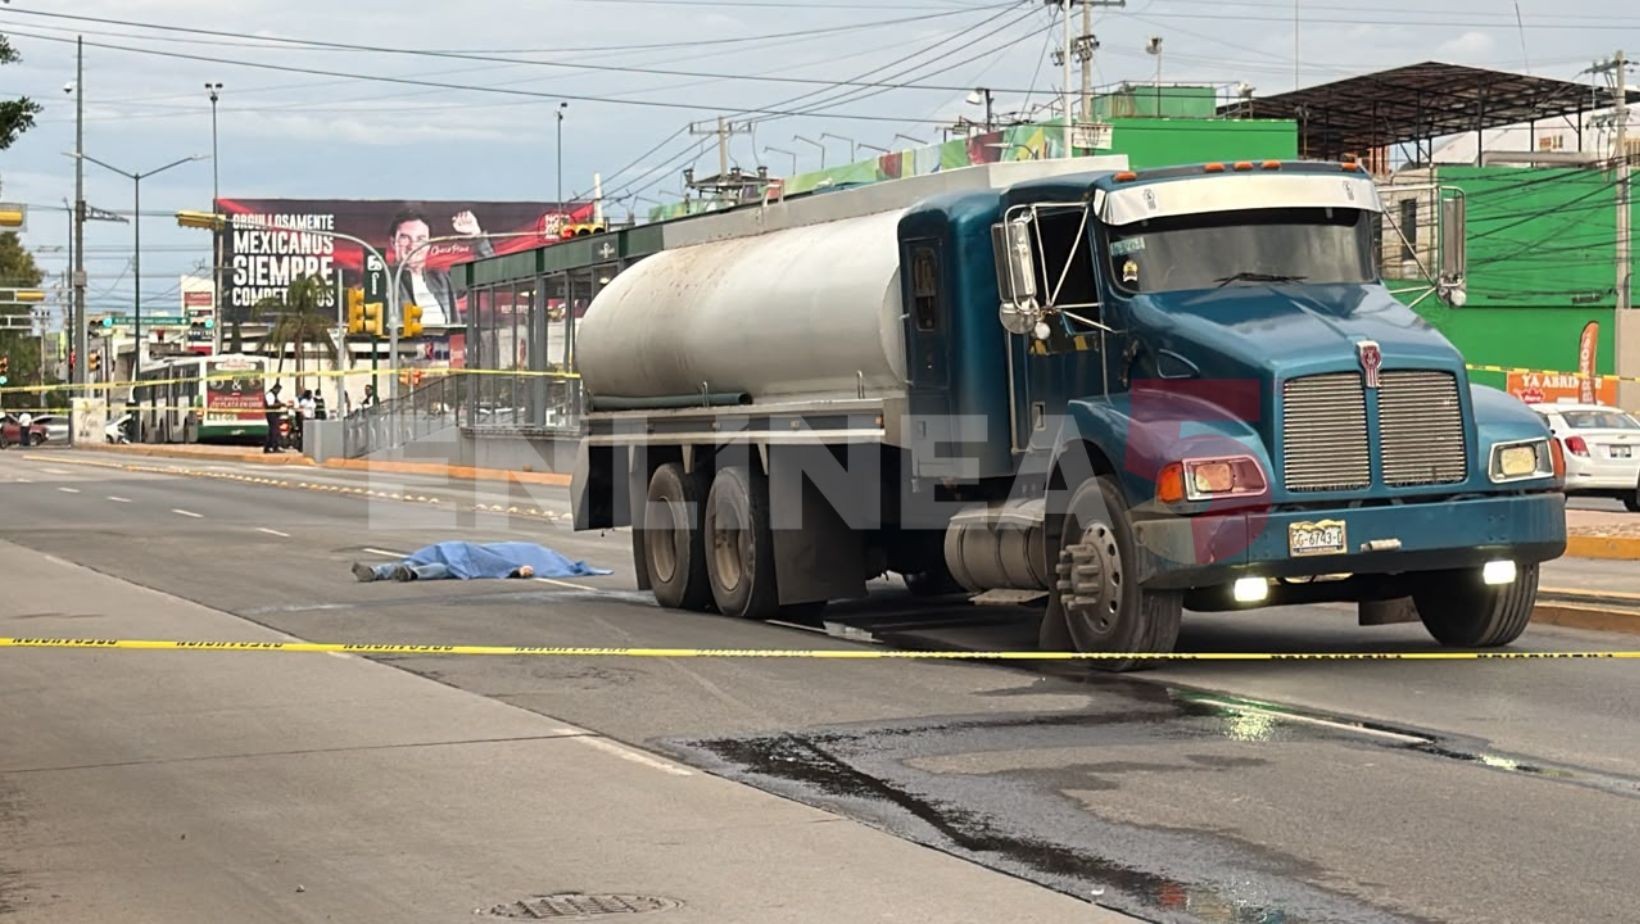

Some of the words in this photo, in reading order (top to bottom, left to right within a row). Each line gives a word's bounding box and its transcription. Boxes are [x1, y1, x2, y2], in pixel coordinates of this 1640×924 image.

[232, 213, 334, 230] ORGULLOSAMENTE
[233, 230, 334, 254] MEXICANOS
[233, 255, 334, 286] SIEMPRE
[232, 286, 334, 307] COMPETOS
[1522, 374, 1540, 387] YA
